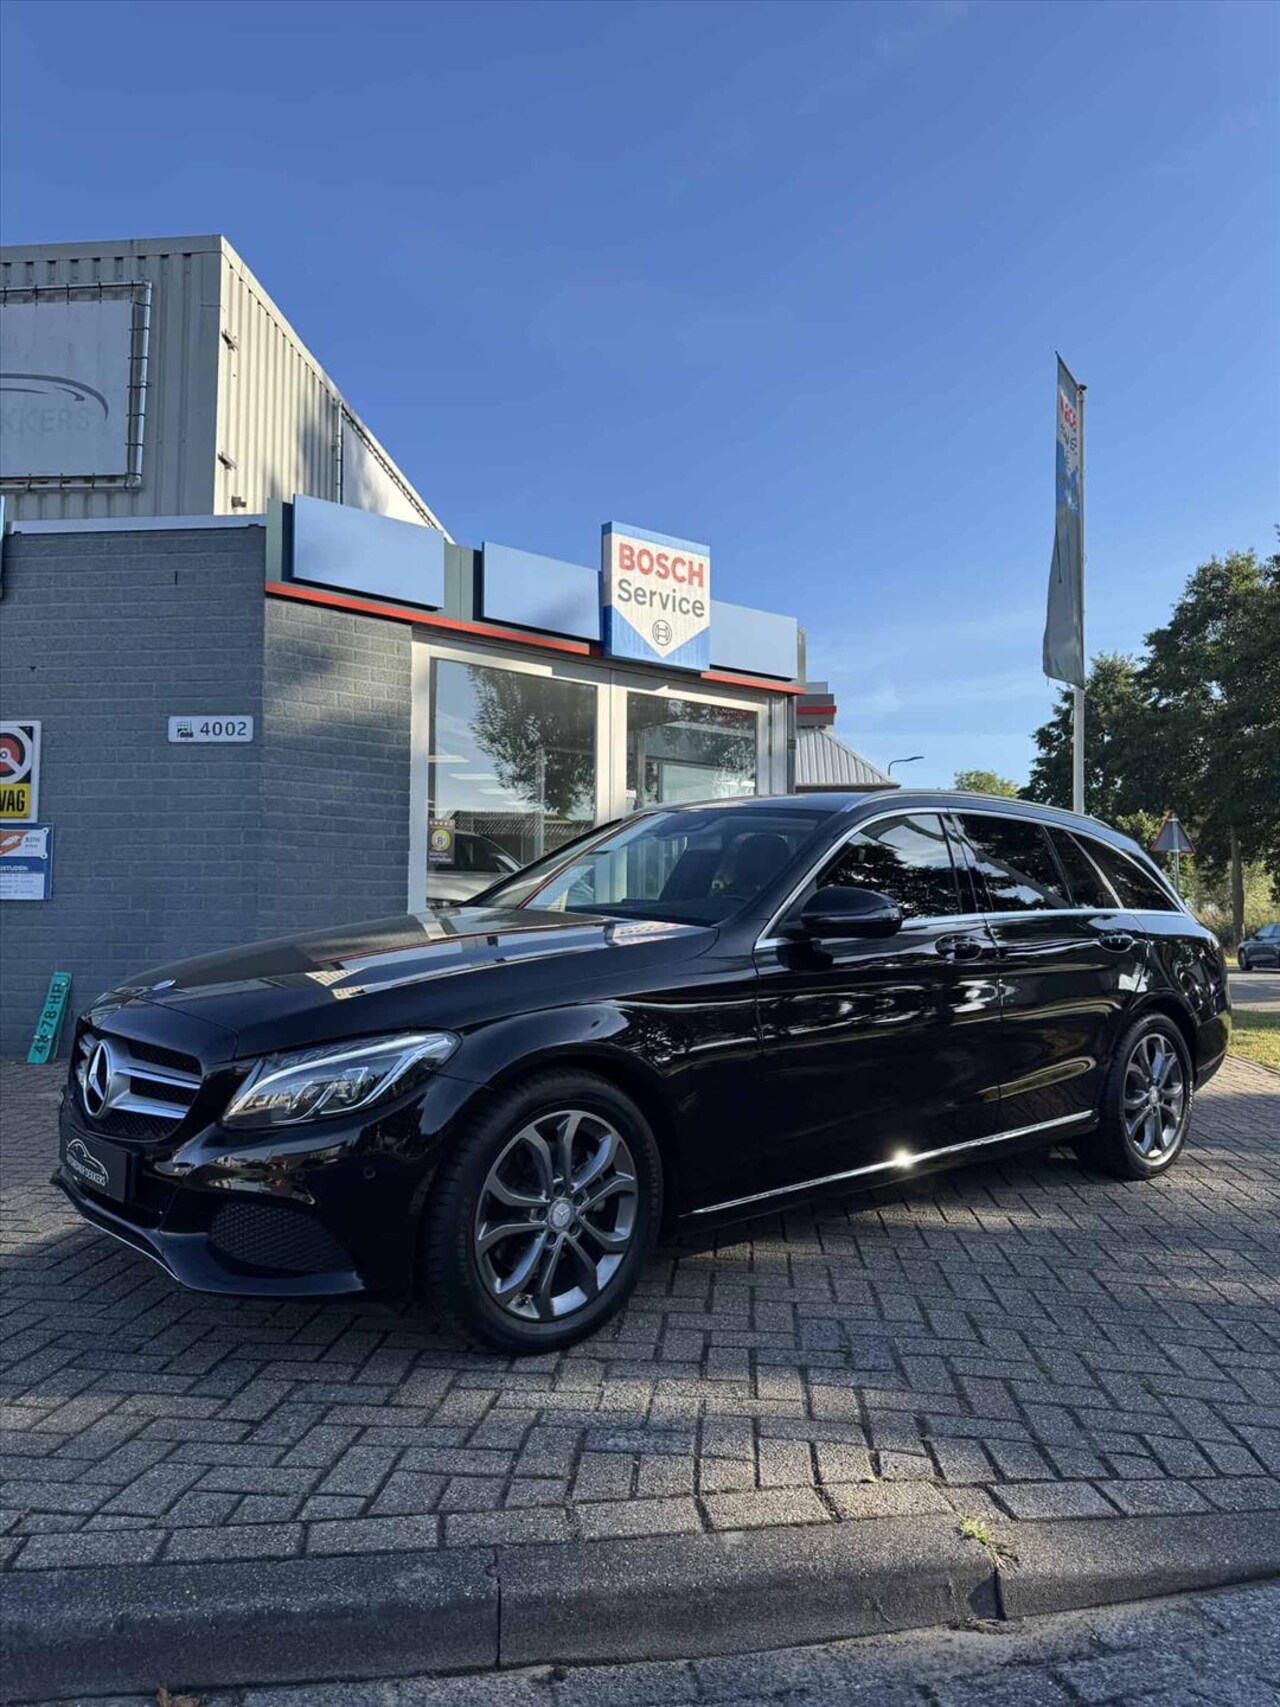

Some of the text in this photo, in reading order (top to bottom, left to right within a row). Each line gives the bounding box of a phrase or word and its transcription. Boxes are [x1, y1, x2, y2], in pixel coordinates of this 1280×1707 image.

[618, 542, 704, 588] BOSCH
[617, 578, 705, 618] Service
[200, 721, 247, 736] 4002
